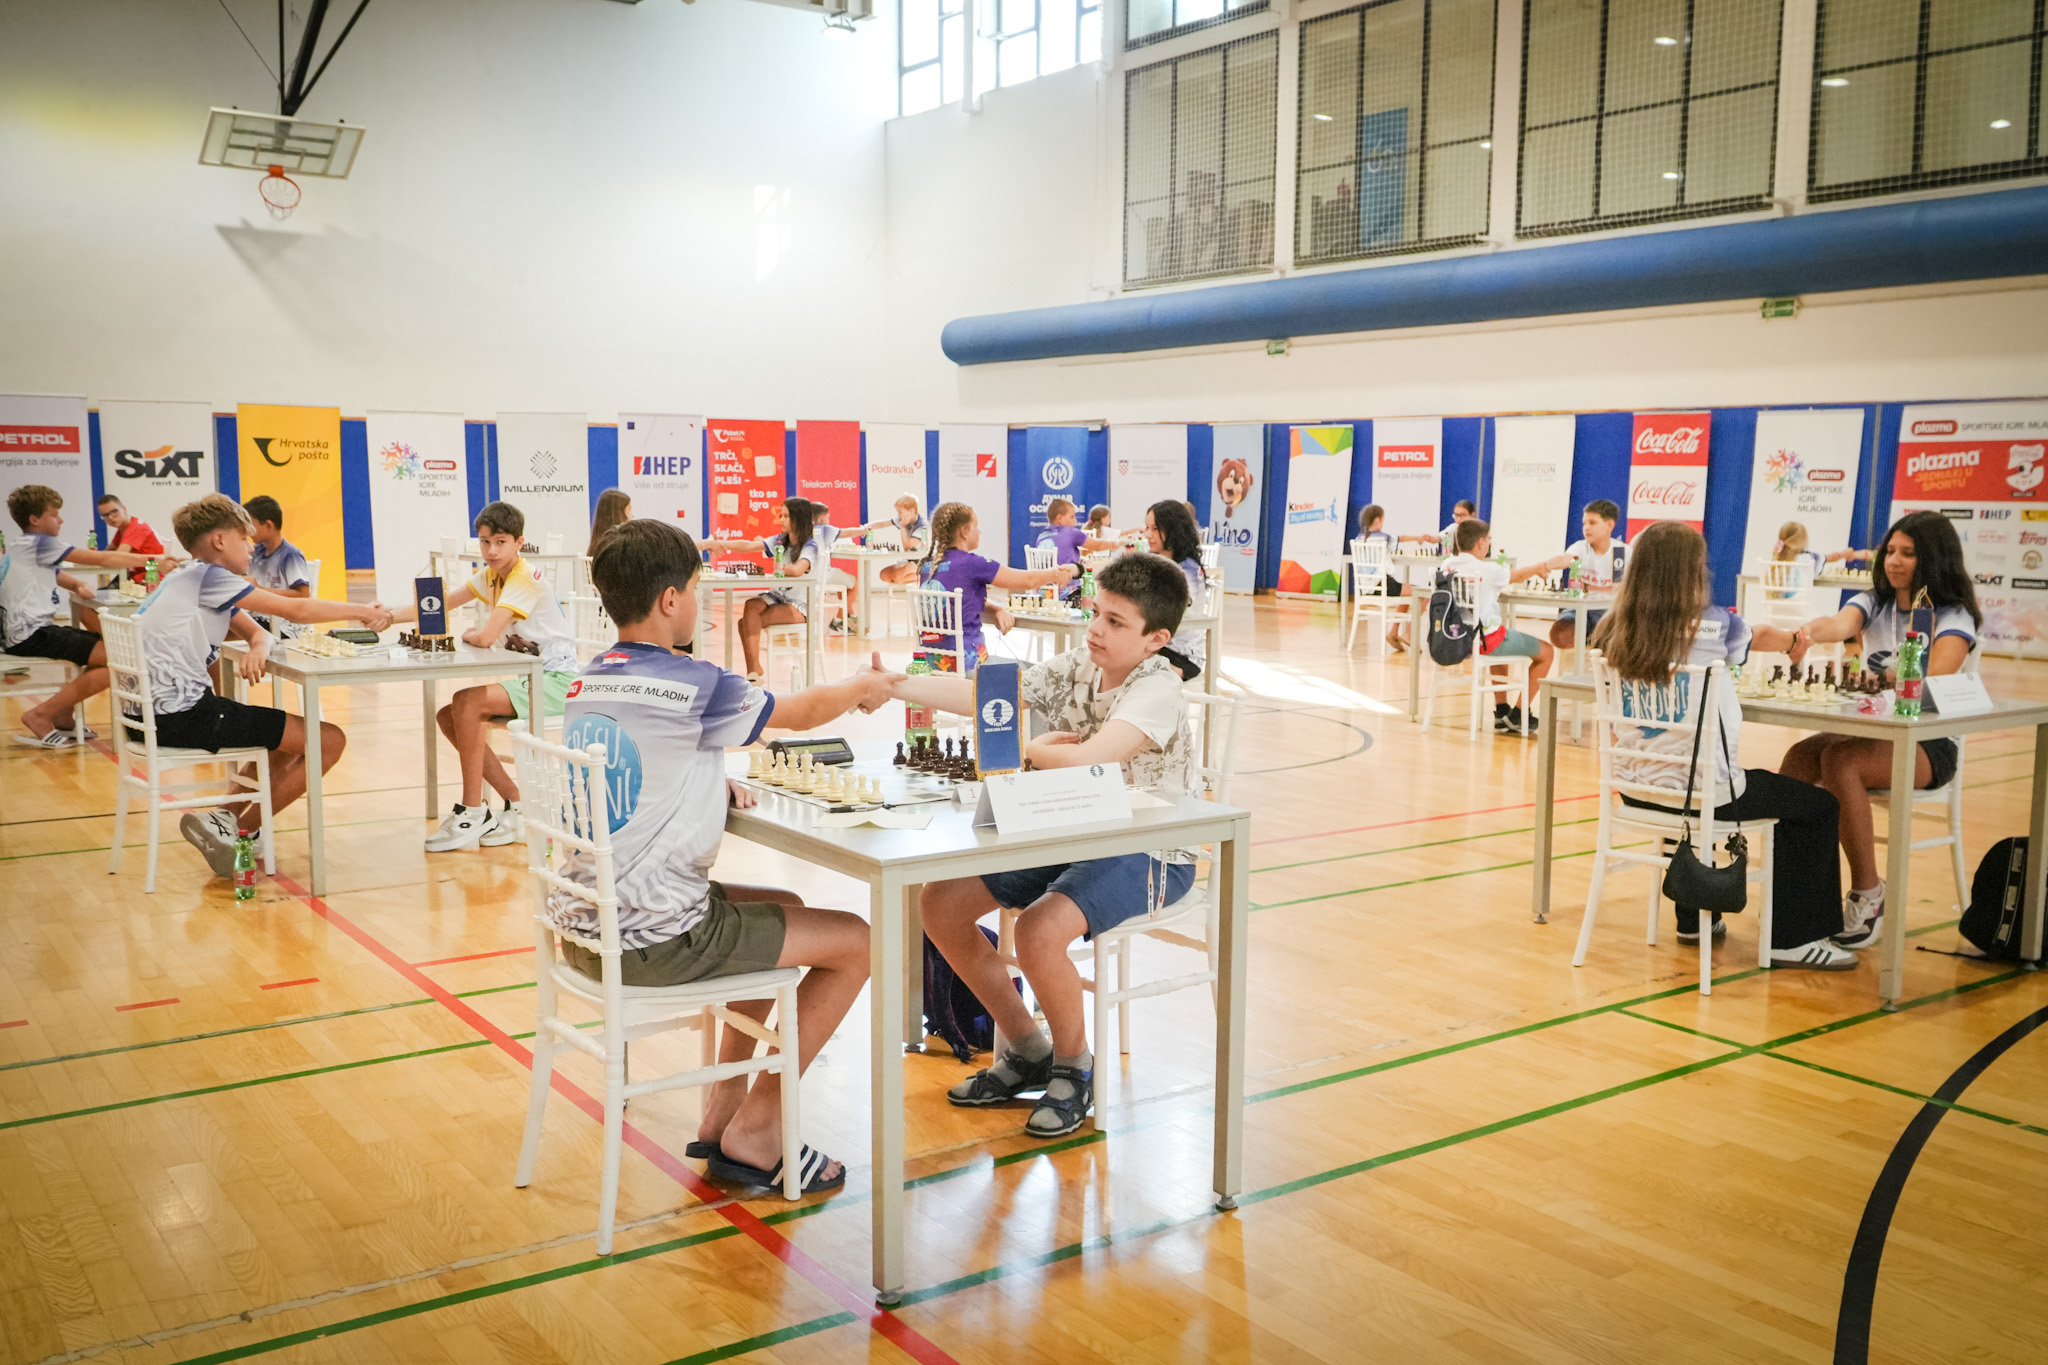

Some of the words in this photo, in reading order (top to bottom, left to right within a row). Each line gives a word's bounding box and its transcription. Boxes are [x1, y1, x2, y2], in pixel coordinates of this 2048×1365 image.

[1914, 422, 1954, 433] plazma
[1962, 423, 2003, 431] SPORTSKE
[2006, 422, 2025, 430] IGRE
[279, 438, 329, 449] Hrvatska
[298, 451, 329, 460] pošta
[714, 450, 738, 461] TRČI,
[1383, 451, 1428, 462] PETROL
[41, 457, 79, 467] življenje
[426, 461, 453, 470] plazma
[653, 456, 691, 475] HEP
[1908, 450, 1980, 477] plazma
[714, 463, 745, 474] SKAČI,
[872, 464, 914, 474] Podravka
[418, 473, 458, 481] SPORTSKE
[714, 475, 741, 485] PLEŠI
[1810, 471, 1841, 480] plazma
[801, 480, 832, 488] Telekom
[835, 480, 856, 489] Srbija
[1799, 485, 1843, 494] SPORTSKE
[749, 489, 764, 498] tko
[749, 500, 769, 512] igra
[1797, 505, 1831, 513] MLADIH
[1213, 521, 1251, 545] Lino
[582, 685, 620, 693] SPORTSKE
[620, 685, 643, 694] IGRE
[643, 687, 690, 703] MLADIH
